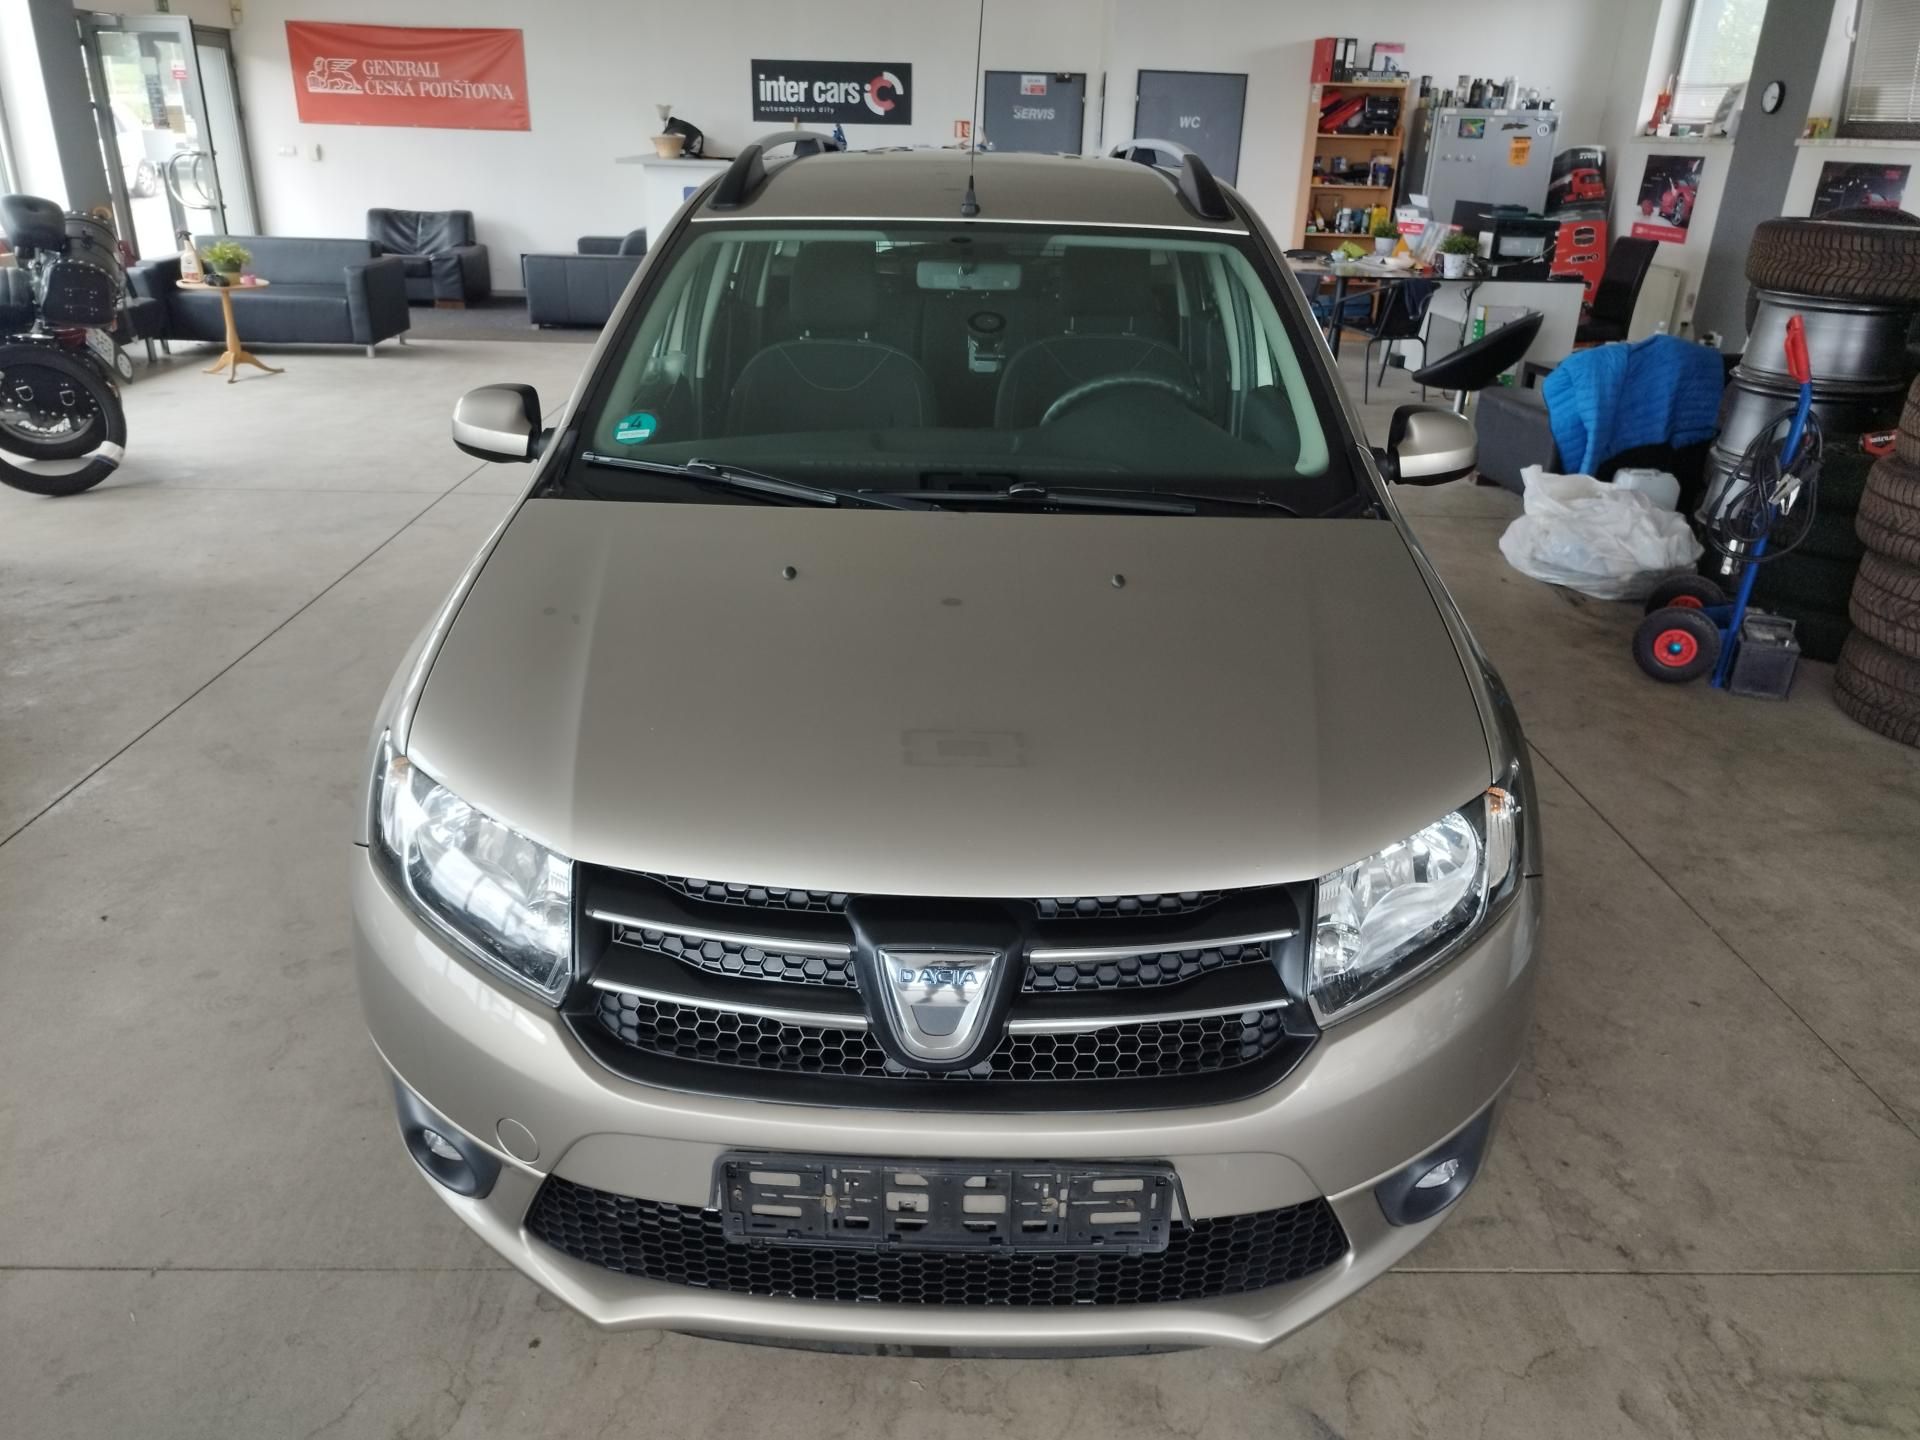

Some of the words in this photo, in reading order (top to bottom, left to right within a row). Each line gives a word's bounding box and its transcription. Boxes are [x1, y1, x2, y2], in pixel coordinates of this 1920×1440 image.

[362, 59, 440, 78] GENERALI
[364, 77, 416, 97] ČESKÁ
[420, 79, 514, 100] POJIŠŤOVNA
[759, 74, 808, 103] inter
[813, 81, 860, 104] cars
[1013, 107, 1055, 120] SERVIS
[1179, 116, 1201, 129] WC
[631, 415, 642, 428] 4
[900, 968, 978, 985] DACIA
